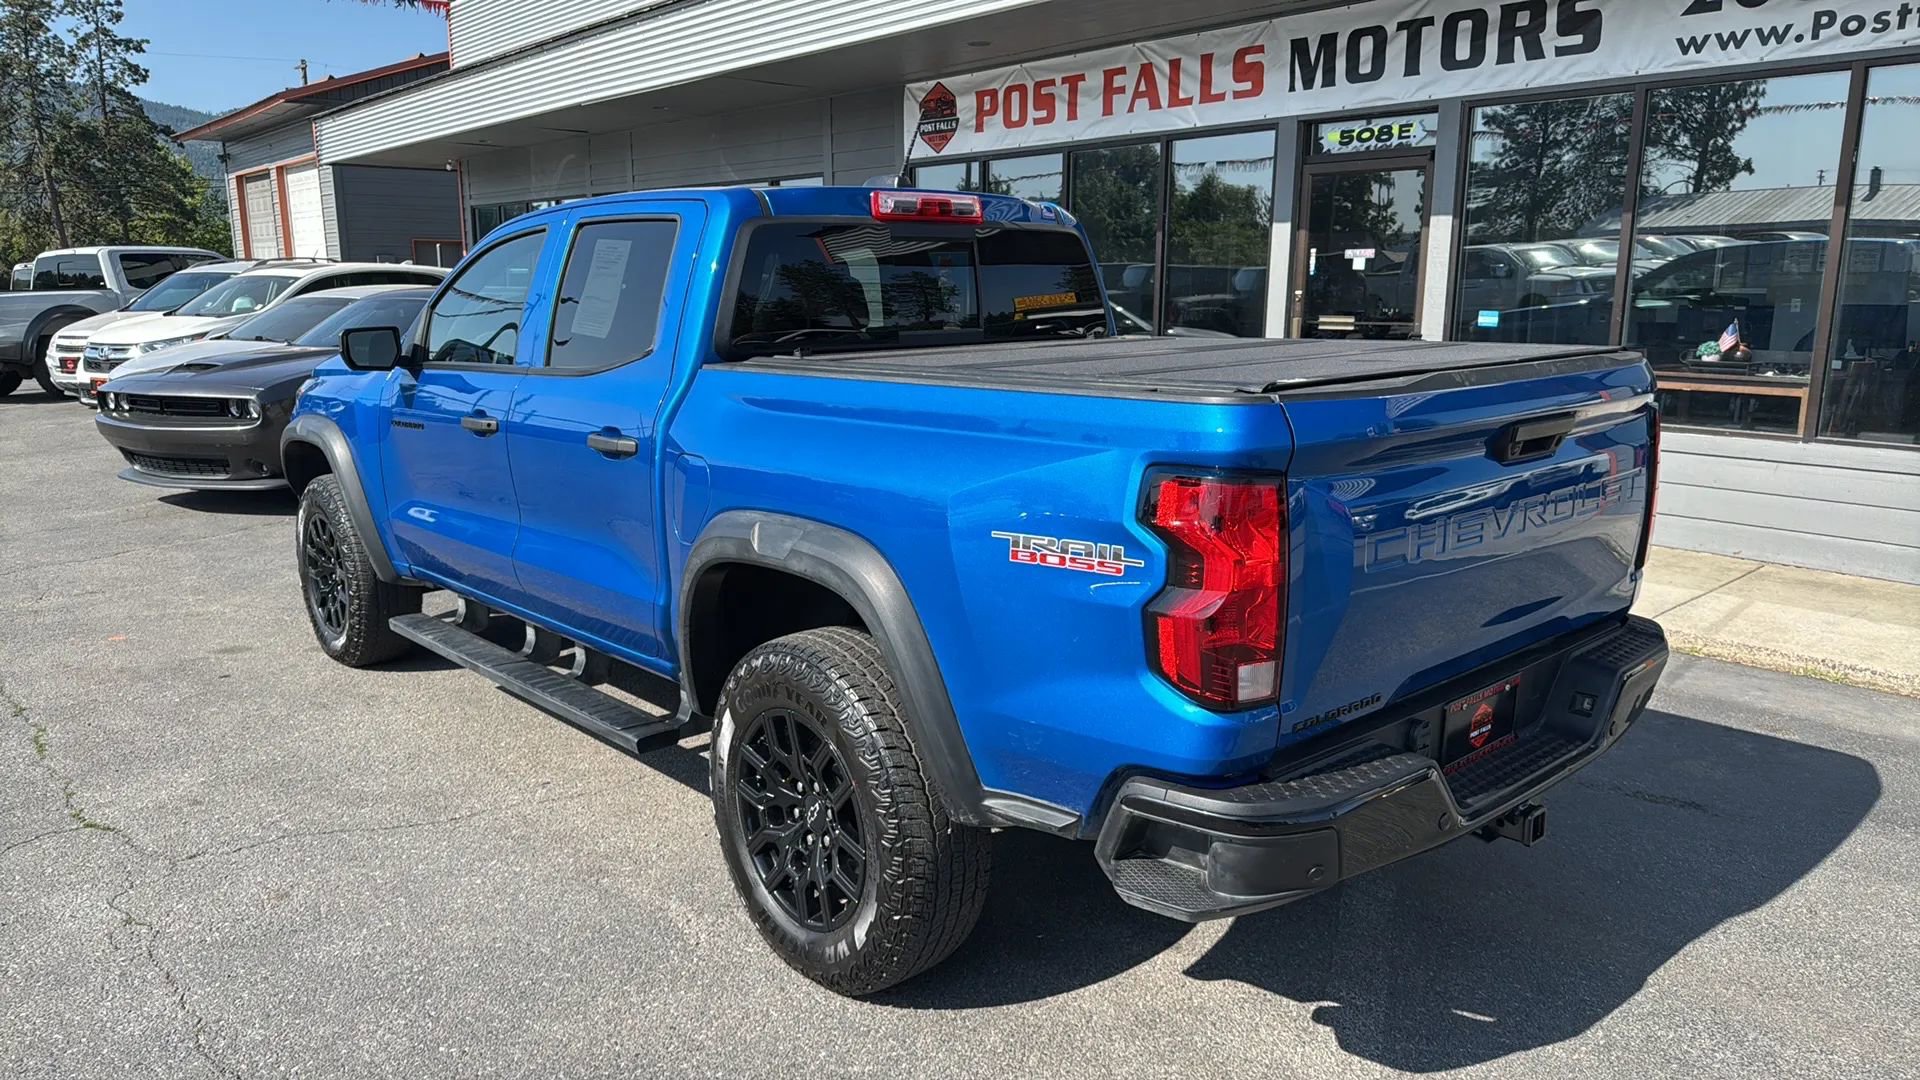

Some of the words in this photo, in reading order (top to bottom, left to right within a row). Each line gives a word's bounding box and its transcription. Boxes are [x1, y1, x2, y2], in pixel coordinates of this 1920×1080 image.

[1676, 2, 1920, 56] www.Post
[974, 73, 1086, 133] POST
[1102, 44, 1266, 117] FALLS
[1288, 0, 1603, 93] MOTORS
[920, 123, 936, 133] POST
[936, 120, 957, 130] FALLS
[1338, 124, 1395, 147] 508
[1364, 468, 1643, 574] CHEVROLET
[991, 531, 1145, 567] TRAIL
[1009, 548, 1124, 577] BOSS
